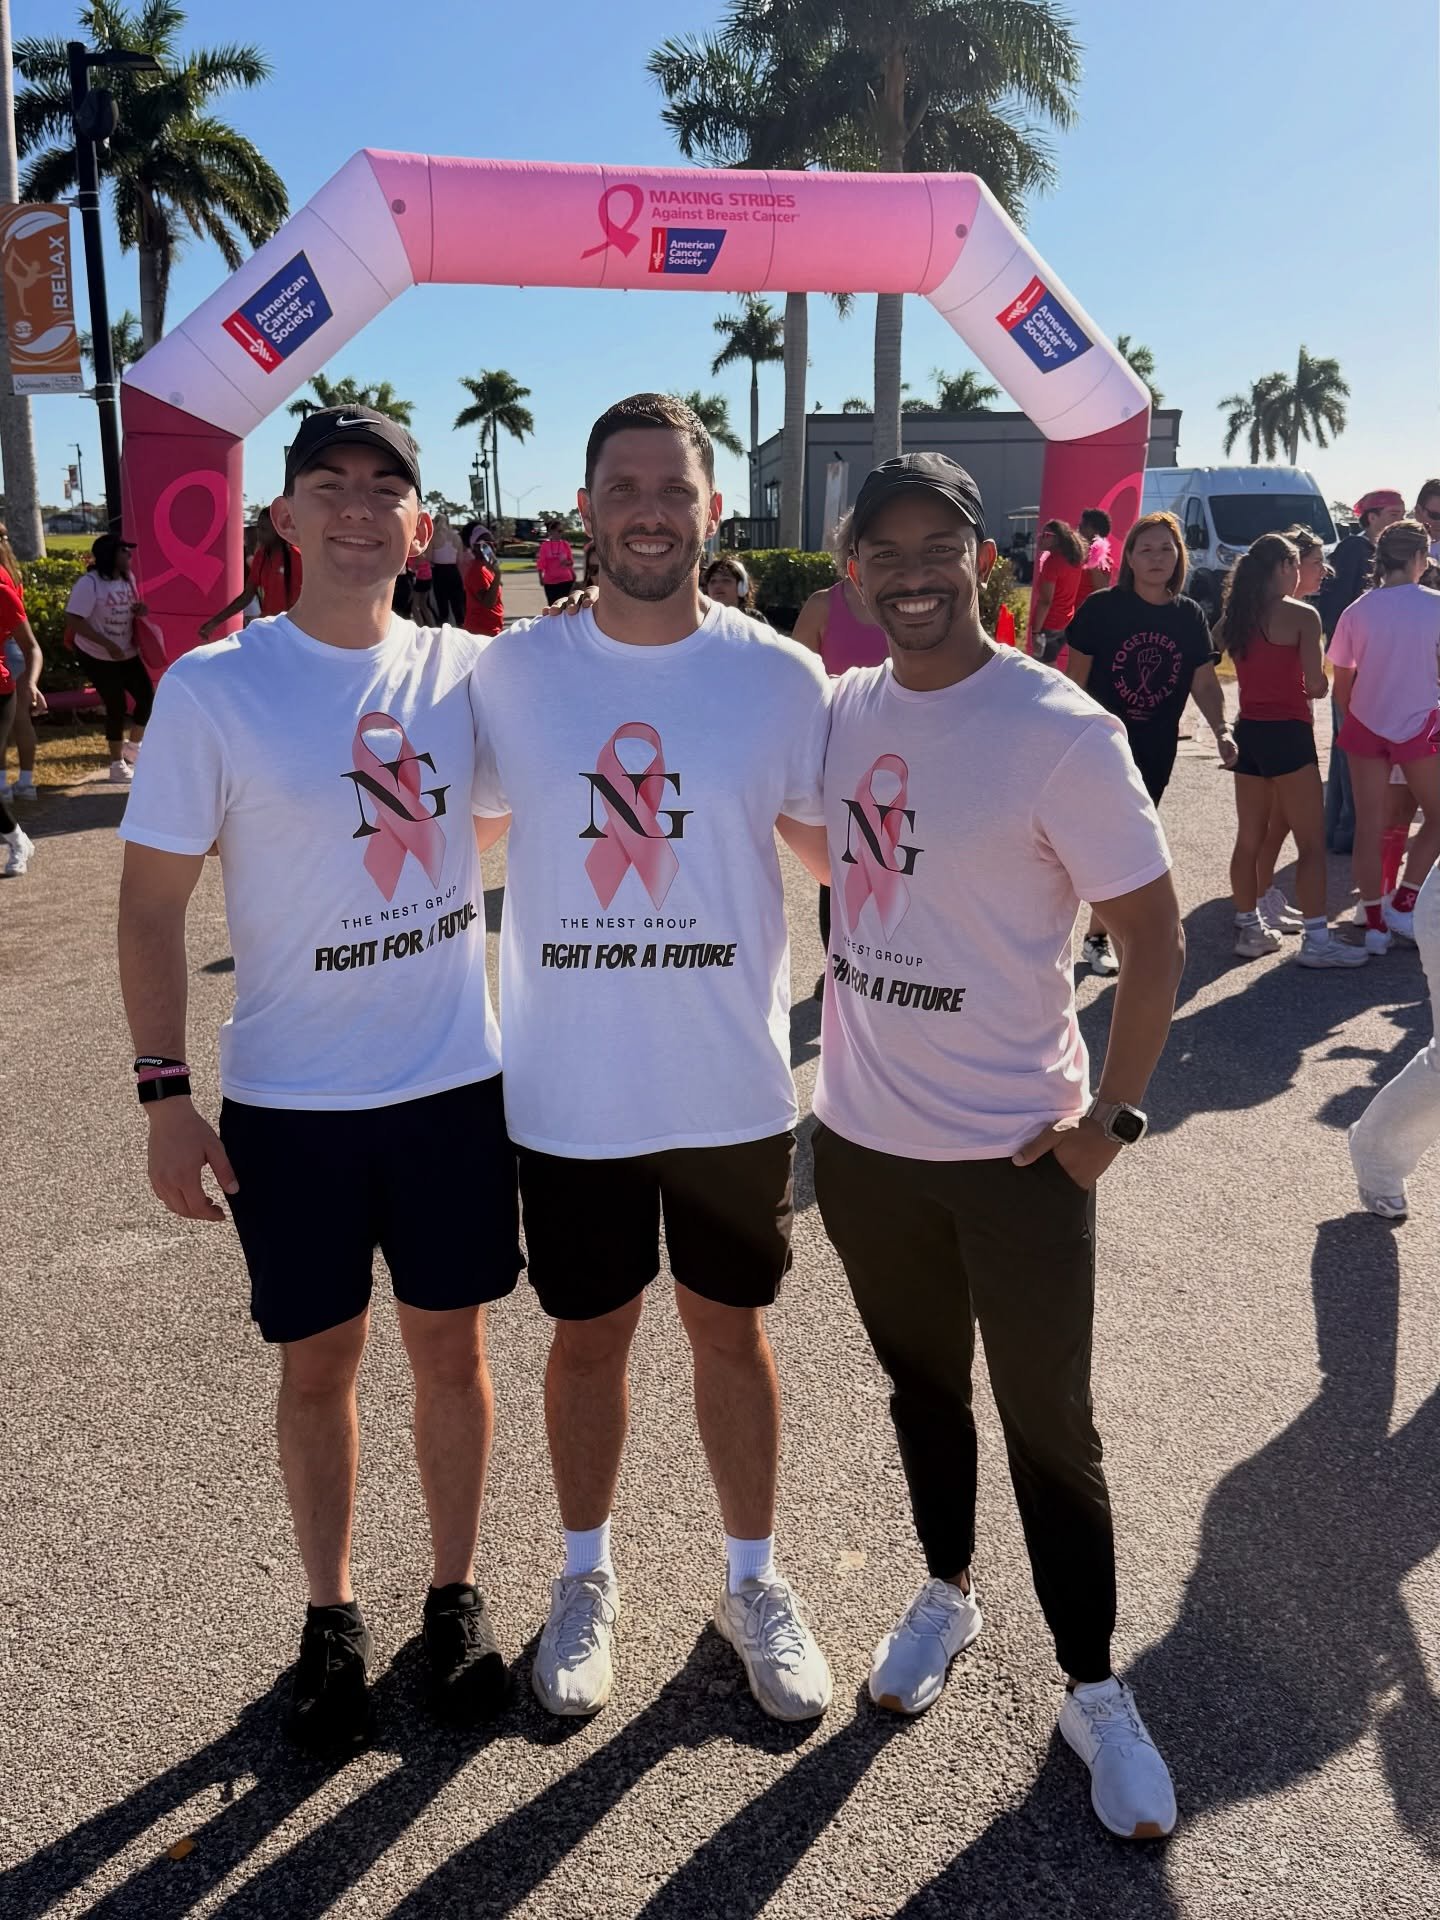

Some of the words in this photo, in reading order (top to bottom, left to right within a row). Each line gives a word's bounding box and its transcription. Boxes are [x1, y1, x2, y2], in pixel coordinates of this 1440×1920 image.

[649, 190, 723, 206] MAKING
[730, 192, 796, 208] STRIDES
[652, 207, 704, 222] Against
[707, 208, 748, 222] Breast
[669, 248, 702, 258] Cancer
[670, 239, 715, 250] American
[48, 235, 68, 309] RELAX
[255, 275, 309, 326] American
[262, 296, 302, 333] Cancer
[1031, 312, 1062, 346] Cancer
[1038, 304, 1078, 352] American
[1112, 632, 1177, 672] TOGETHER
[1168, 652, 1183, 684] FOR
[1114, 675, 1145, 708] CURE
[1147, 686, 1173, 707] THE
[340, 752, 452, 839] NG
[578, 772, 694, 839] NG
[841, 798, 925, 876] NG
[341, 915, 373, 930] THE
[380, 903, 419, 922] NEST
[560, 918, 589, 929] THE
[596, 918, 636, 929] NEST
[644, 918, 697, 929] GROUP
[314, 940, 379, 972] FIGHT
[382, 929, 425, 962] FOR
[541, 943, 592, 969] FIGHT
[594, 943, 638, 970] FOR
[640, 943, 658, 969] A
[661, 943, 737, 969] FUTURE
[875, 949, 924, 967] GROUP
[851, 966, 868, 997] FOR
[870, 976, 885, 1001] A
[887, 979, 966, 1013] FUTURE
